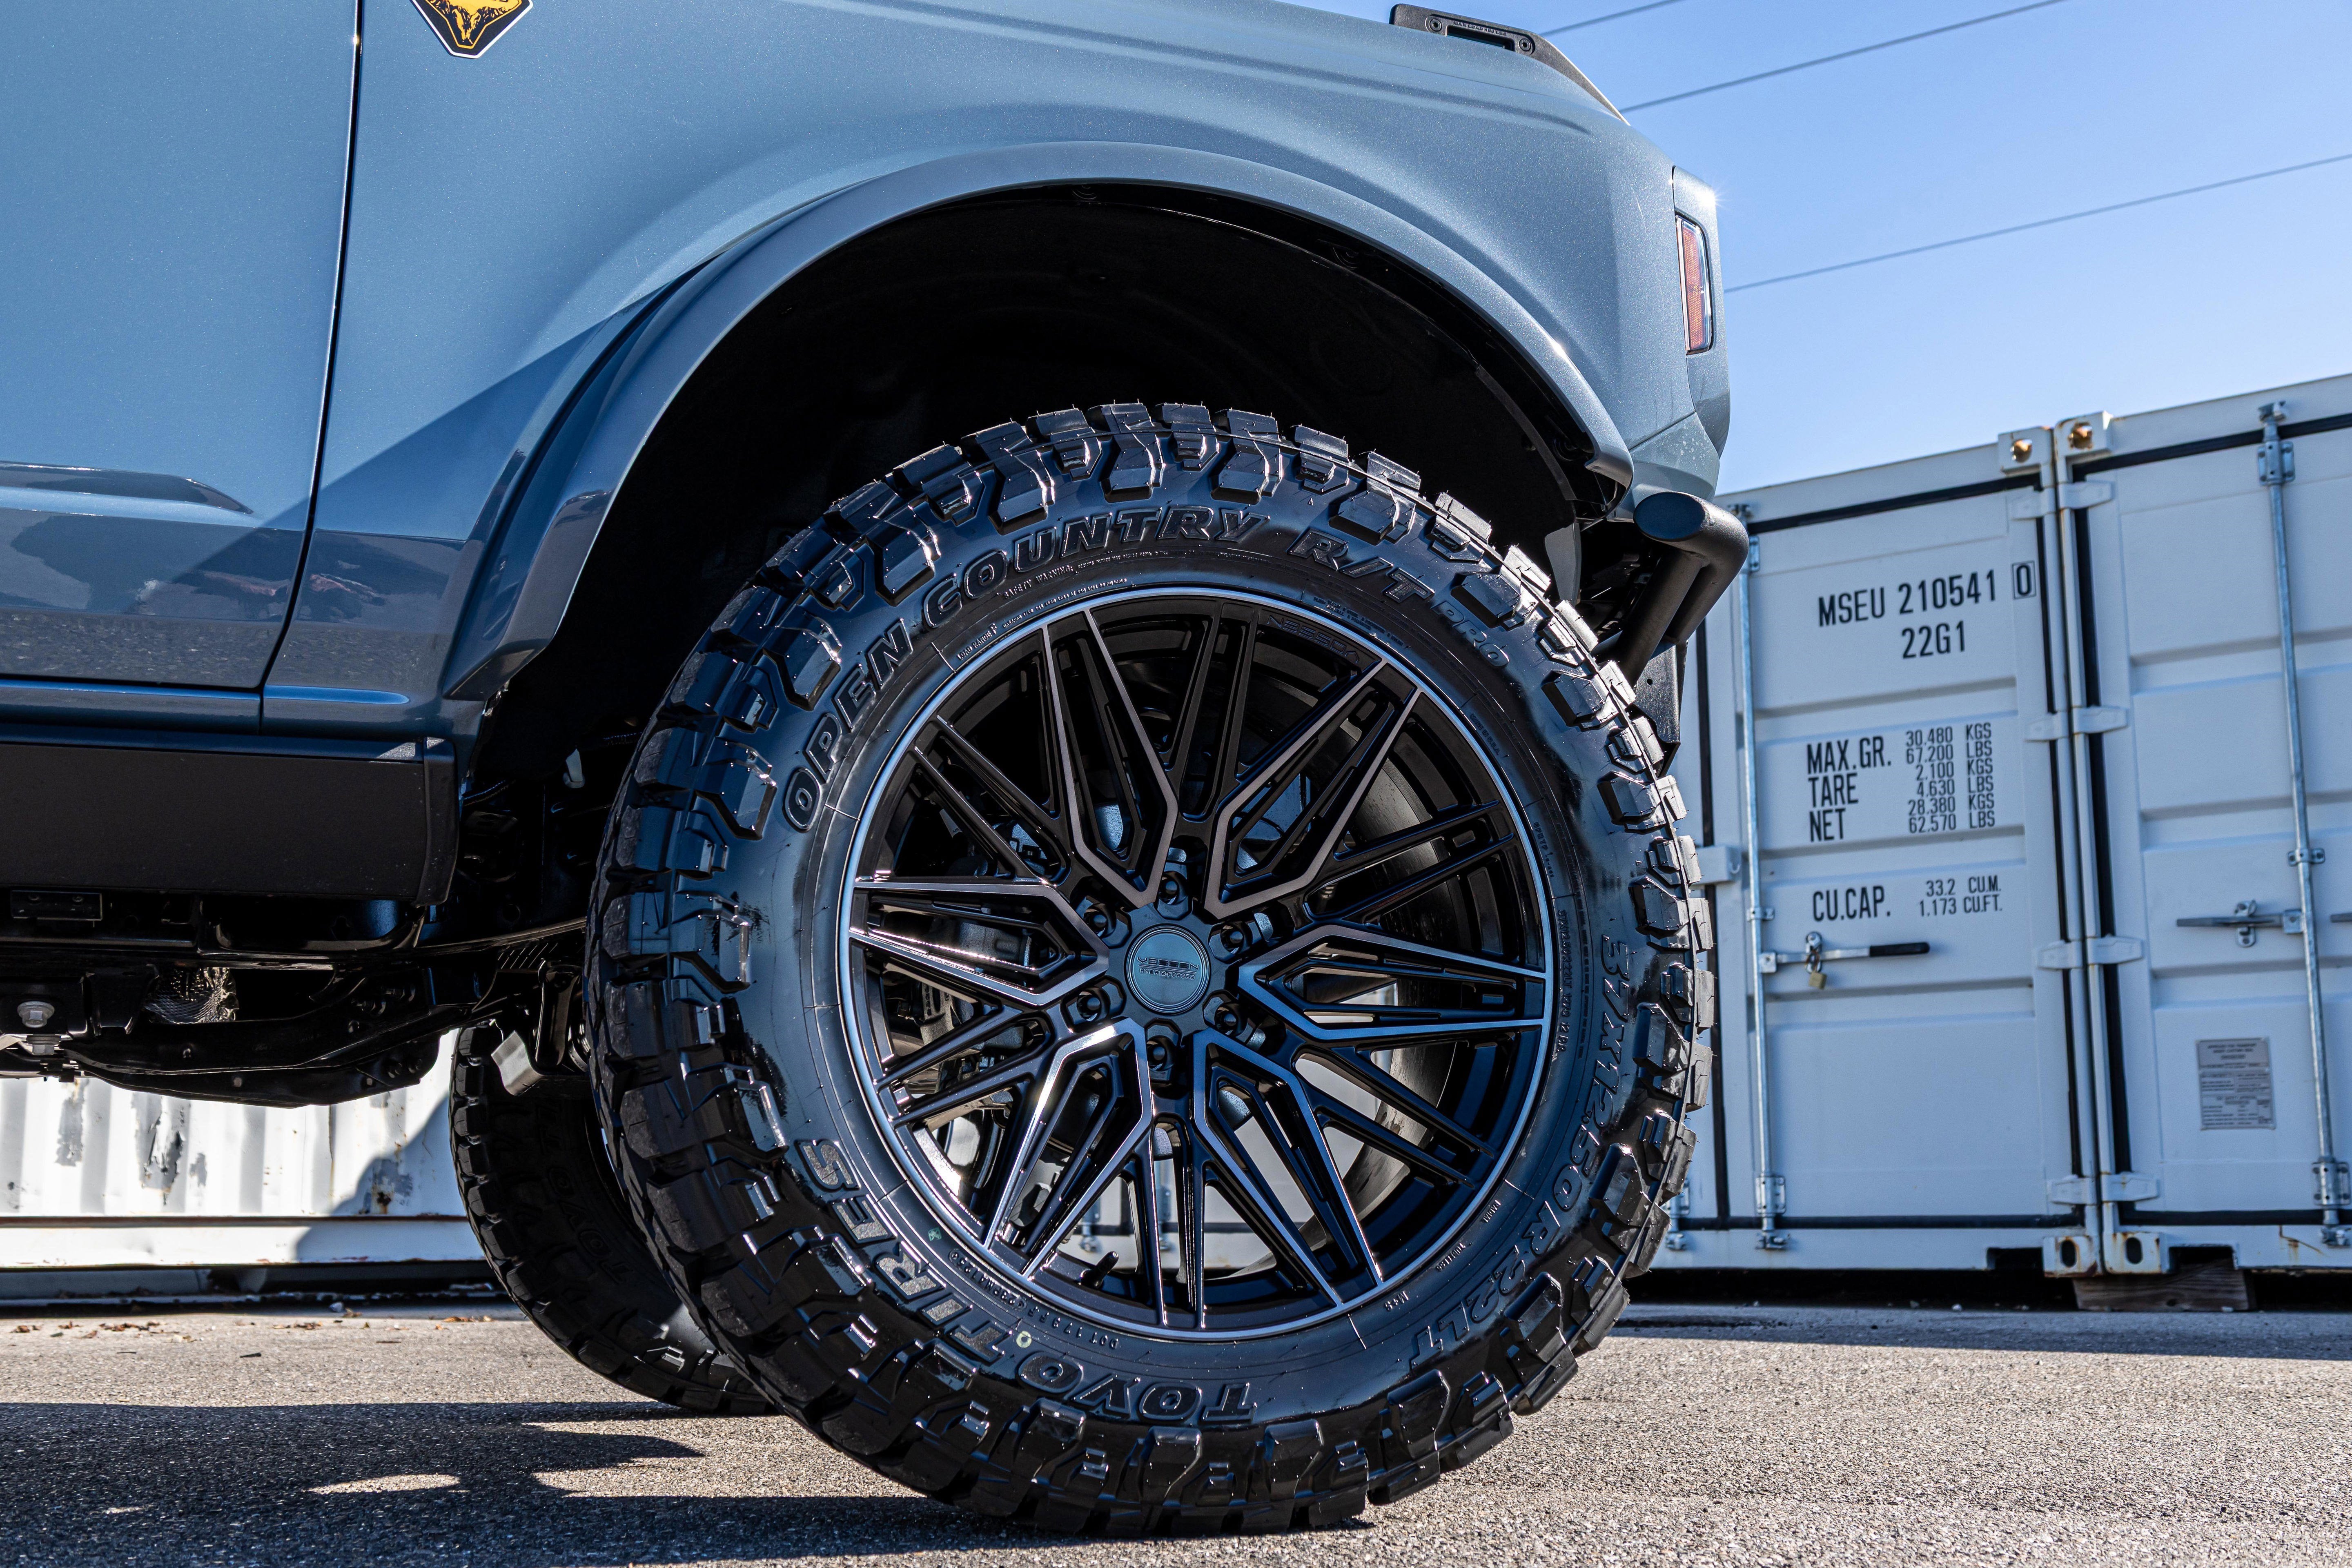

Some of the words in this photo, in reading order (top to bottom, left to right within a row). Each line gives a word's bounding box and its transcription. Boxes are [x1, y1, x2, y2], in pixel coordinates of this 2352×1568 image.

[1818, 586, 1885, 627] MSEU
[1898, 569, 1996, 615] 210541
[1267, 615, 1360, 664] VOSSEN
[1901, 620, 1965, 659] 22G1
[782, 617, 914, 831] OPEN
[922, 506, 1270, 629] COUNTRY
[1286, 528, 1434, 604] R/T
[1429, 599, 1512, 669] PRO
[1807, 736, 1892, 775] MAX.GR.
[1966, 722, 1992, 741] KGS
[1967, 740, 1992, 759] LBS
[1808, 773, 1859, 808] TARE
[1967, 757, 1993, 775] KGS
[1968, 775, 1994, 793] LBS
[1809, 808, 1846, 842] NET
[1969, 793, 1995, 811] KGS
[1969, 810, 1995, 829] LBS
[1812, 885, 1891, 922] CU.CAP.
[1926, 878, 1956, 897] 33.2
[1137, 956, 1200, 970] VOSSEN
[1561, 1022, 1570, 1033] 12
[798, 1139, 1013, 1364] TIRES
[1018, 1350, 1258, 1424] TOYO
